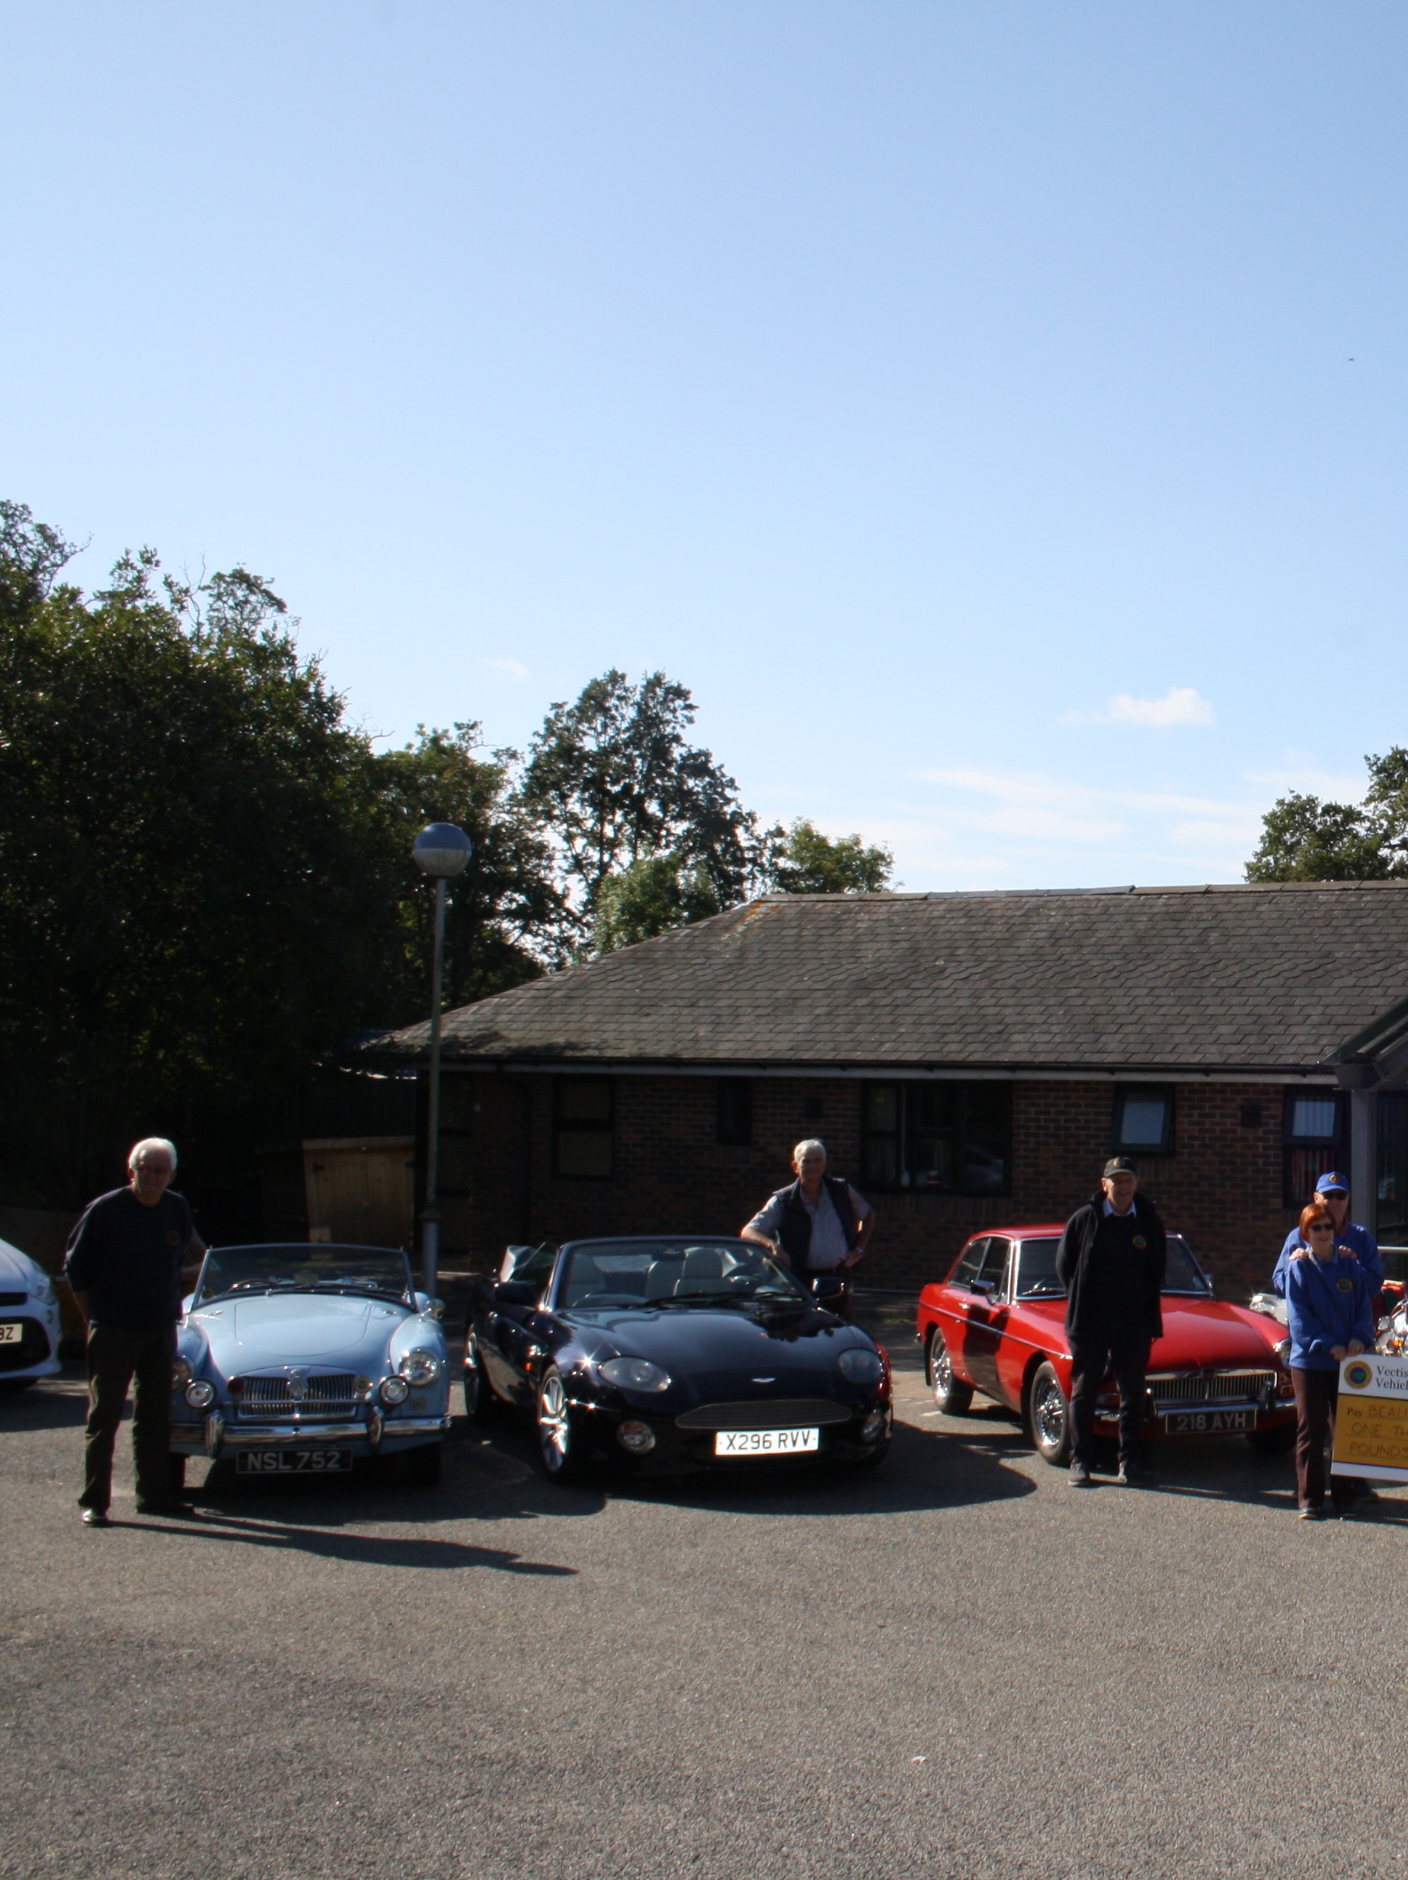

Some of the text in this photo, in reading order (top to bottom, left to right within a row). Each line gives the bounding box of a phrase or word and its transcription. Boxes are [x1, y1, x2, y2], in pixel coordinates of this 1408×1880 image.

[1376, 1365, 1408, 1378] Vectis
[1176, 1411, 1246, 1432] 218 AYH
[1346, 1407, 1363, 1418] Pay
[1351, 1422, 1383, 1437] ONE
[726, 1429, 811, 1451] X296 RVV
[247, 1450, 341, 1471] NSL 752
